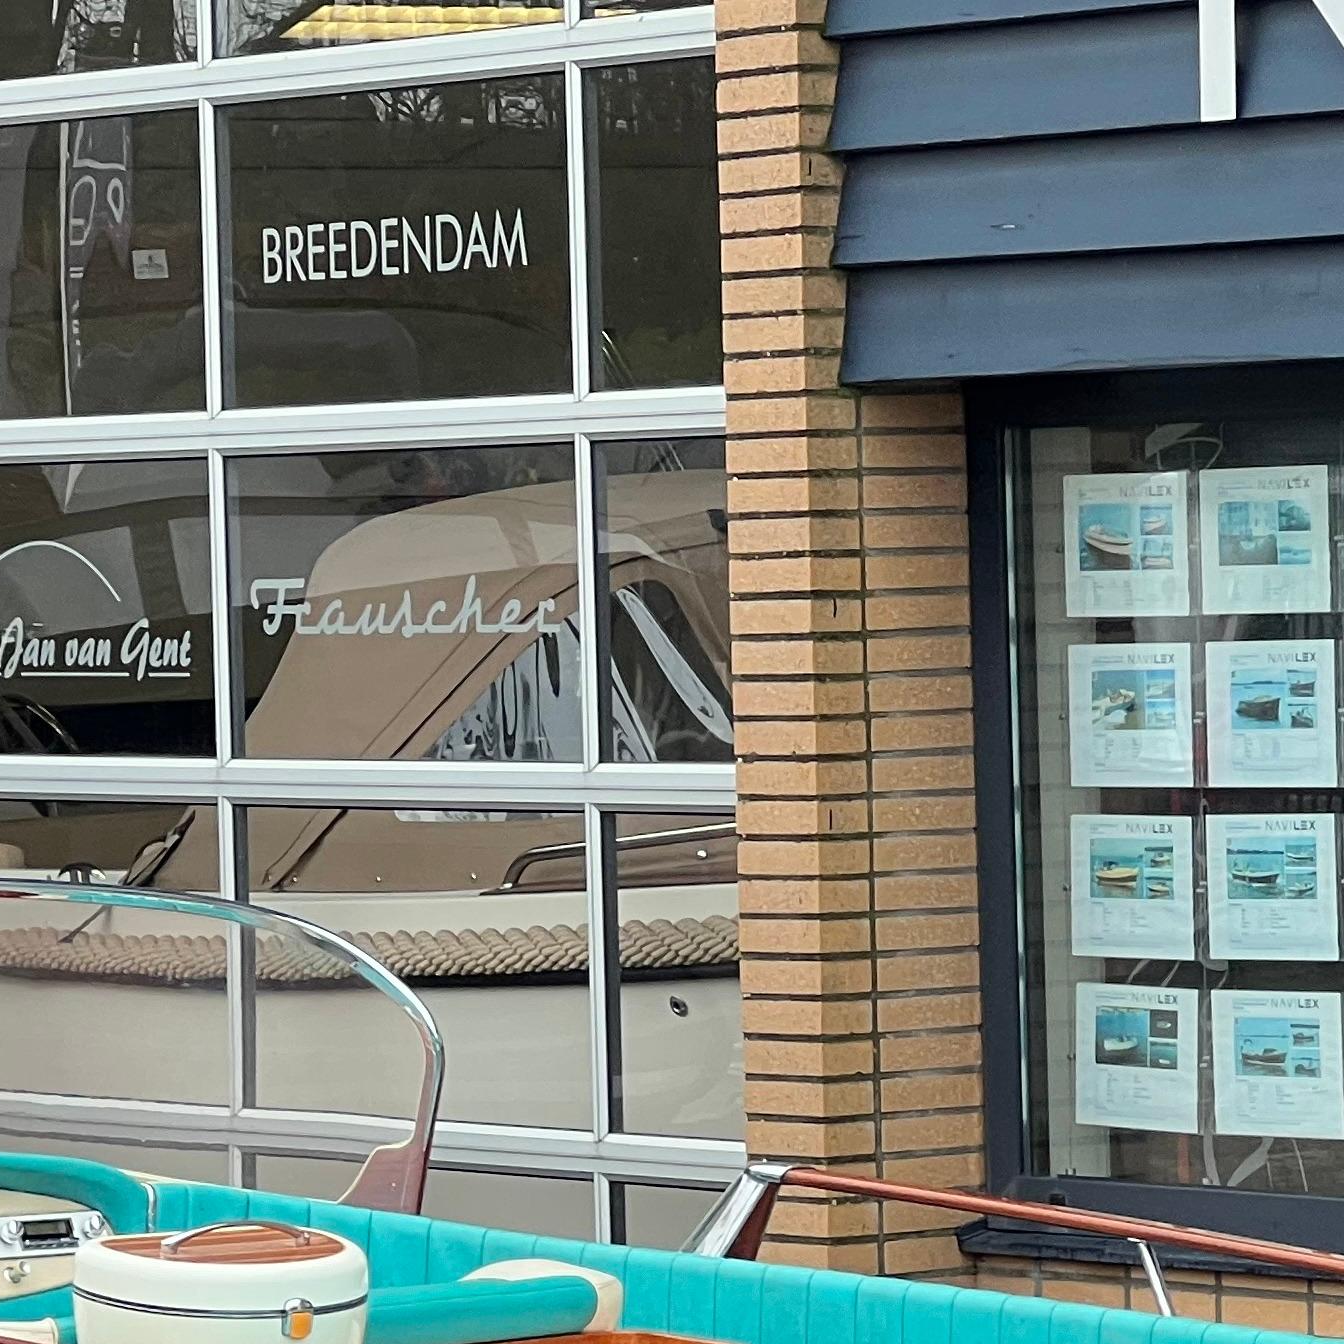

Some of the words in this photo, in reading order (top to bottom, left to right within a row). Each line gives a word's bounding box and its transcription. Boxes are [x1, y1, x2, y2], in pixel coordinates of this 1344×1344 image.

[262, 208, 528, 283] BREEDENDAM
[250, 574, 561, 638] Frauscher
[64, 637, 112, 668] van
[120, 617, 192, 682] Gent
[1125, 823, 1173, 834] NAVILEX
[1265, 820, 1316, 831] NAVILEX
